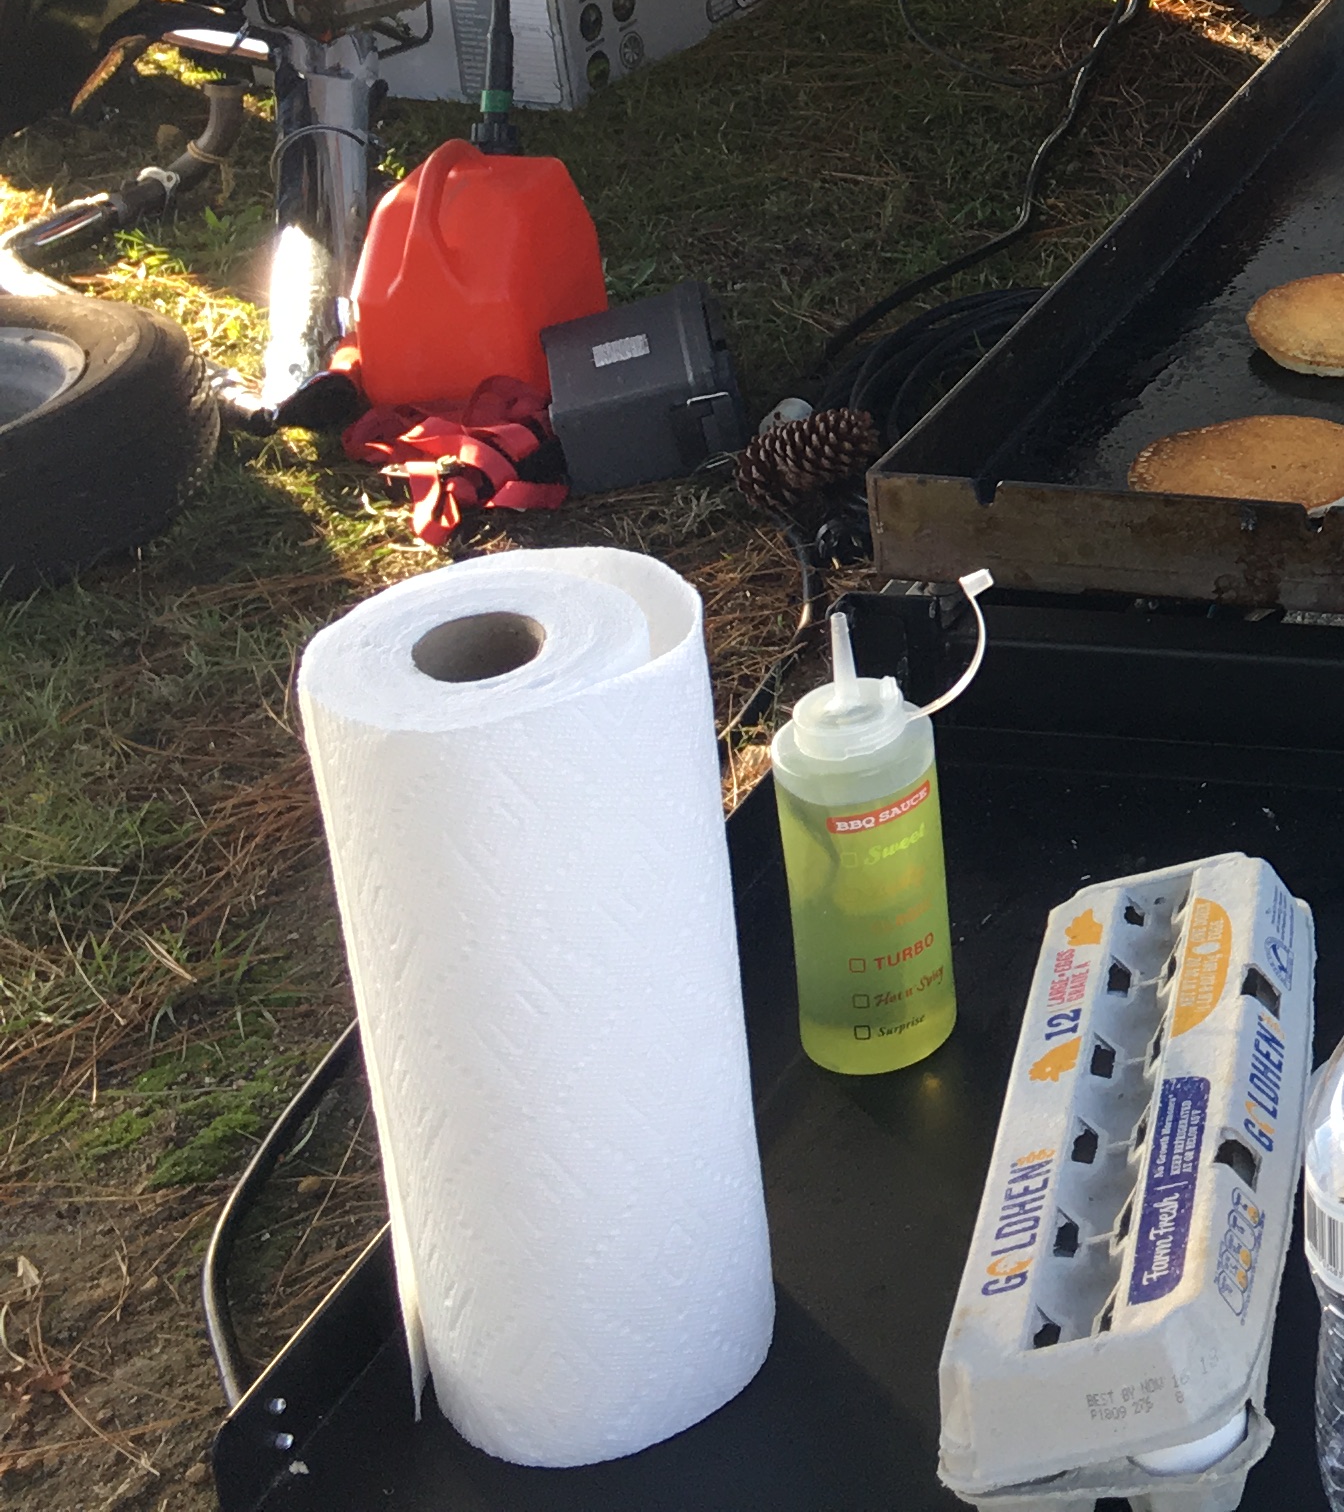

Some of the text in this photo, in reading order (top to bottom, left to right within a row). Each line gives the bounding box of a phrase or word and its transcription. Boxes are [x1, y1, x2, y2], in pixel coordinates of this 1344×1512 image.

[835, 787, 928, 832] BBQ SAUCE
[864, 821, 926, 866] Sweet
[873, 931, 935, 971] TURBO
[1066, 969, 1090, 1003] GRADE
[878, 1014, 926, 1038] Surprise
[1044, 1007, 1083, 1041] 12
[1156, 1136, 1170, 1165] Growth
[1169, 1099, 1193, 1176] KEEP REFRIGERATED
[1185, 1127, 1198, 1150] BELOW
[1184, 1149, 1195, 1162] OR
[1142, 1192, 1180, 1286] Farm Fresh
[1085, 1390, 1114, 1407] BEST
[1121, 1386, 1135, 1402] BY
